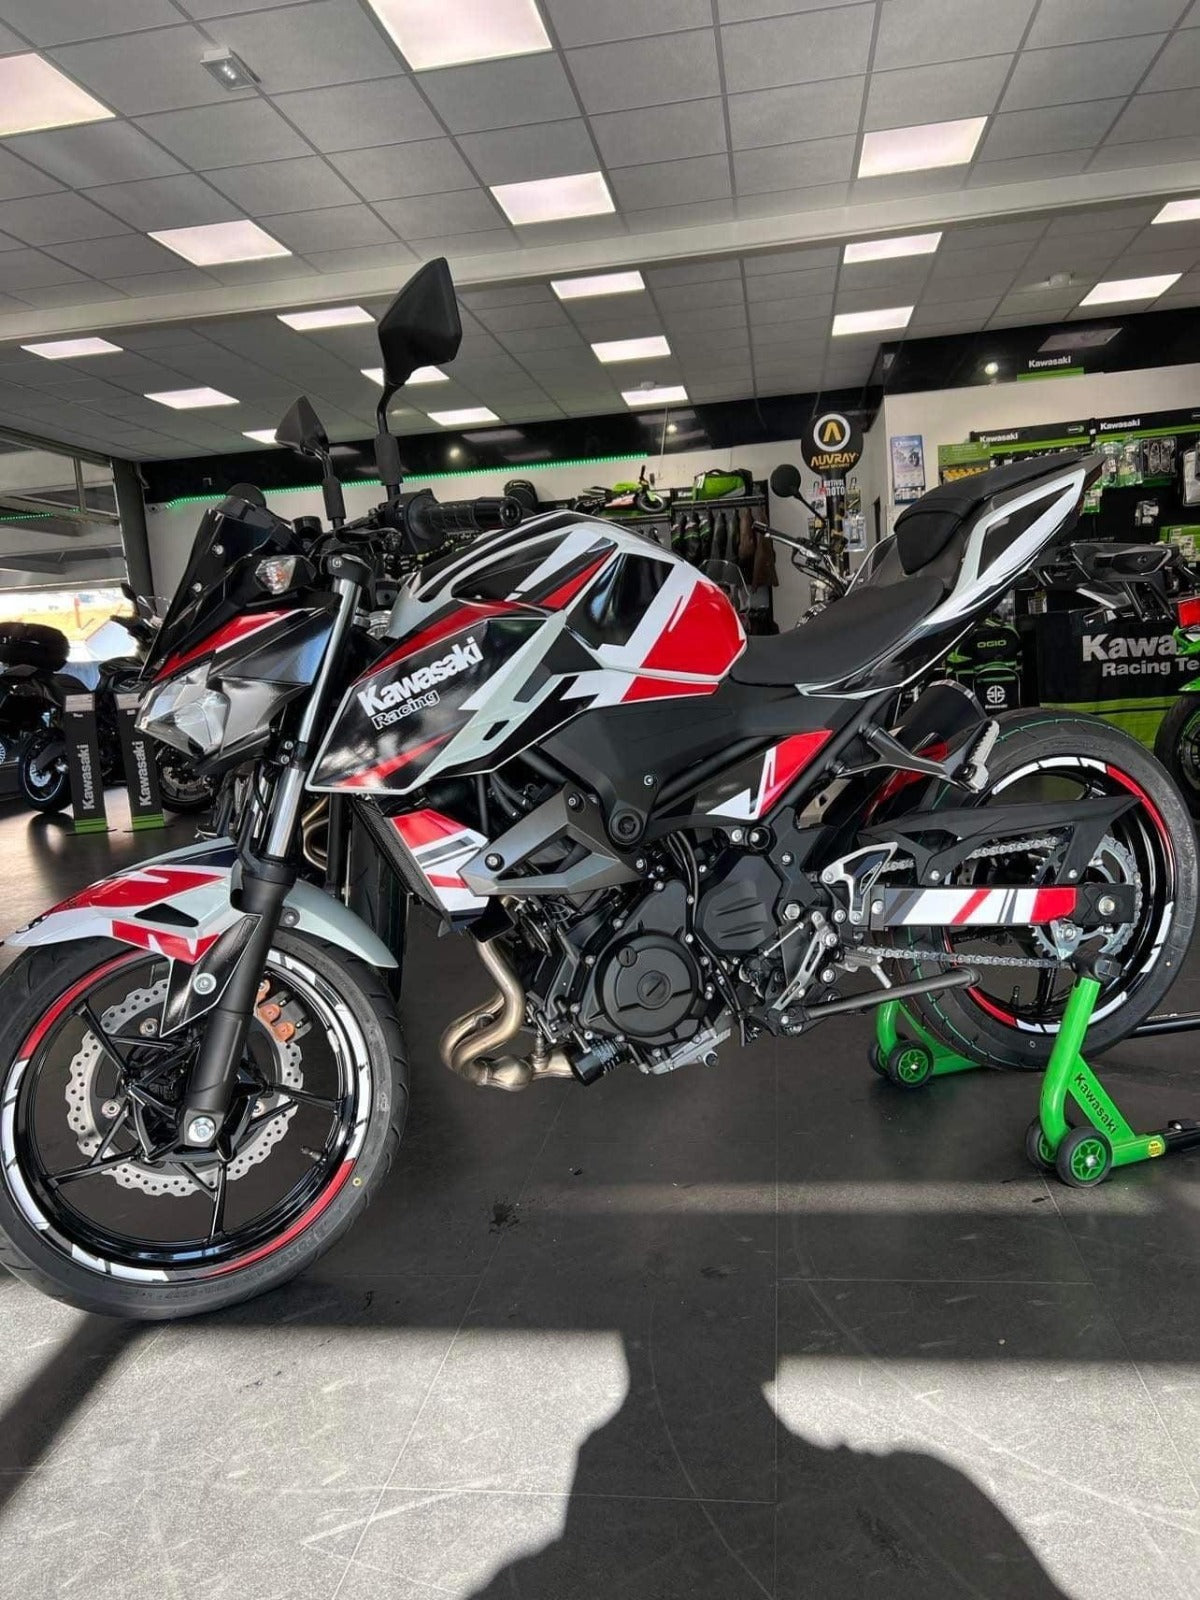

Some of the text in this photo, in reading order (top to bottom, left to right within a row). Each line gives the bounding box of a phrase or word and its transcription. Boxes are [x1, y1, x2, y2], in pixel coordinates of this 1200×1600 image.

[1028, 355, 1072, 369] Kawasaki
[1100, 418, 1141, 431] Kawasaki
[979, 431, 1019, 444] Kawasaki
[811, 452, 857, 467] AUVRAY
[976, 639, 1007, 649] OGIO
[357, 636, 484, 717] Kawasaki
[1102, 660, 1171, 677] Racing
[371, 689, 440, 730] Racing
[76, 743, 95, 811] Kawasaki
[131, 740, 152, 807] Kawasaki
[1073, 1072, 1118, 1134] Kawasaki
